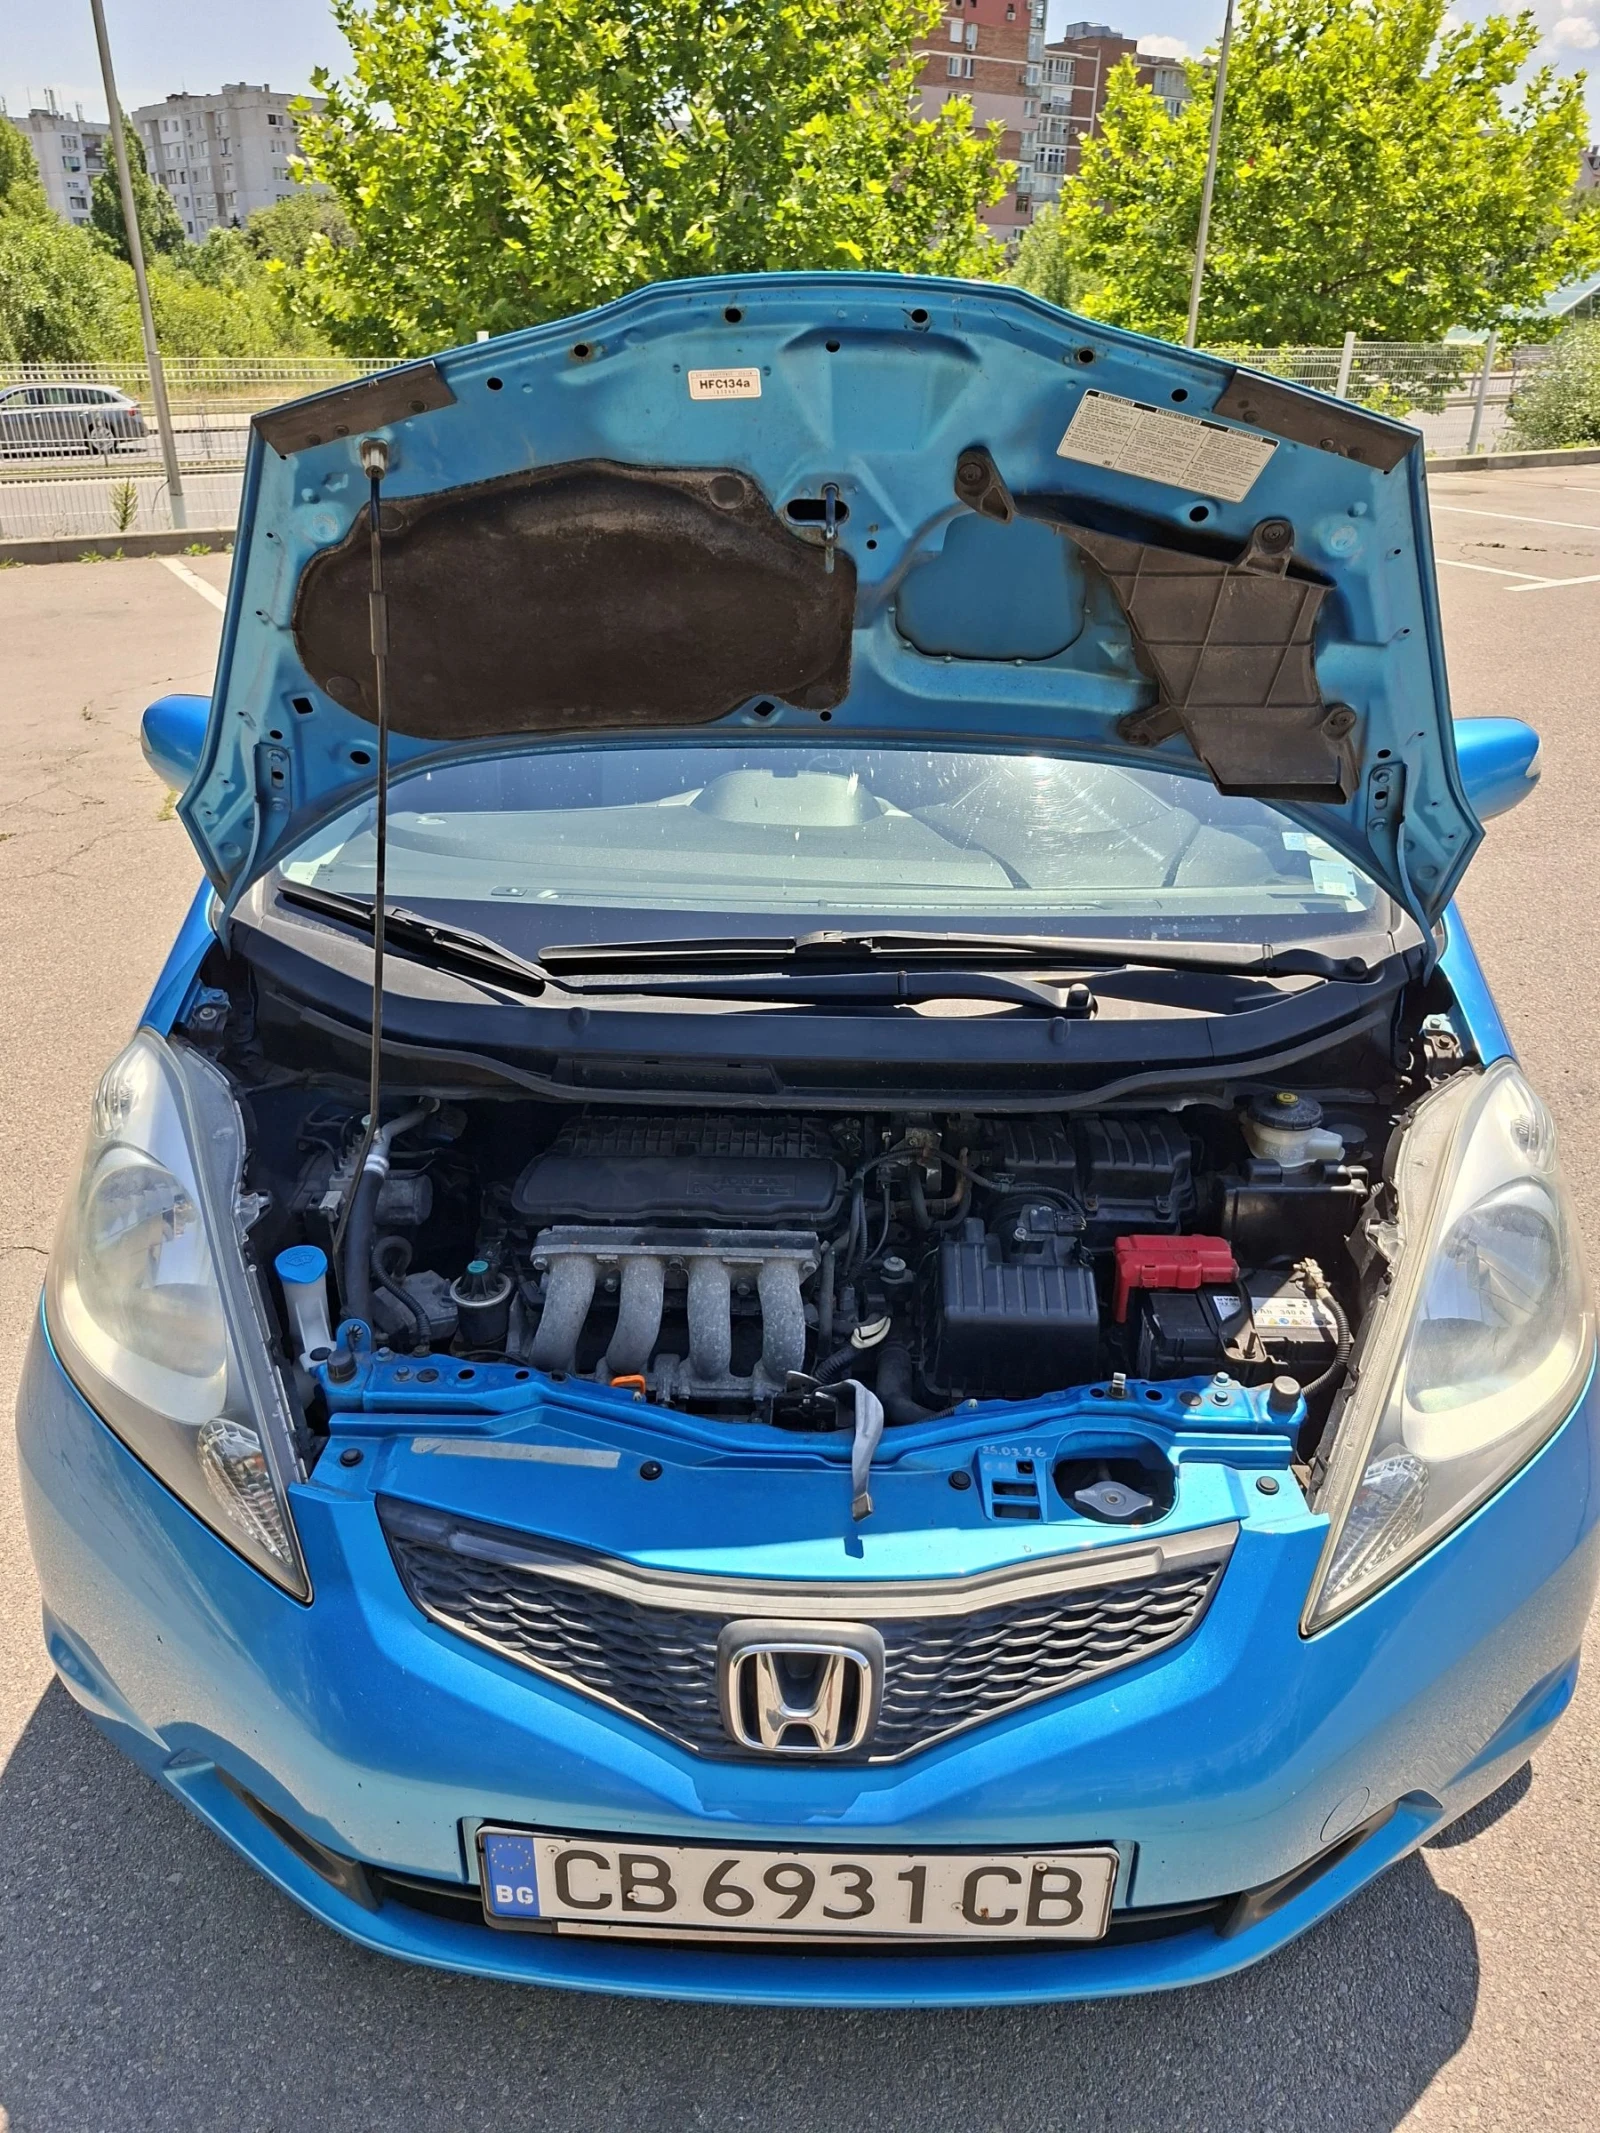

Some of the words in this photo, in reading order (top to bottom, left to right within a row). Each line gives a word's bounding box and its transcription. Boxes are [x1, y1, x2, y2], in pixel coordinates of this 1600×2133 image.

[699, 378, 751, 390] HFC134a
[495, 1884, 534, 1905] BG
[554, 1849, 678, 1913] CB
[702, 1859, 927, 1924] 6931
[961, 1866, 1084, 1927] CB
